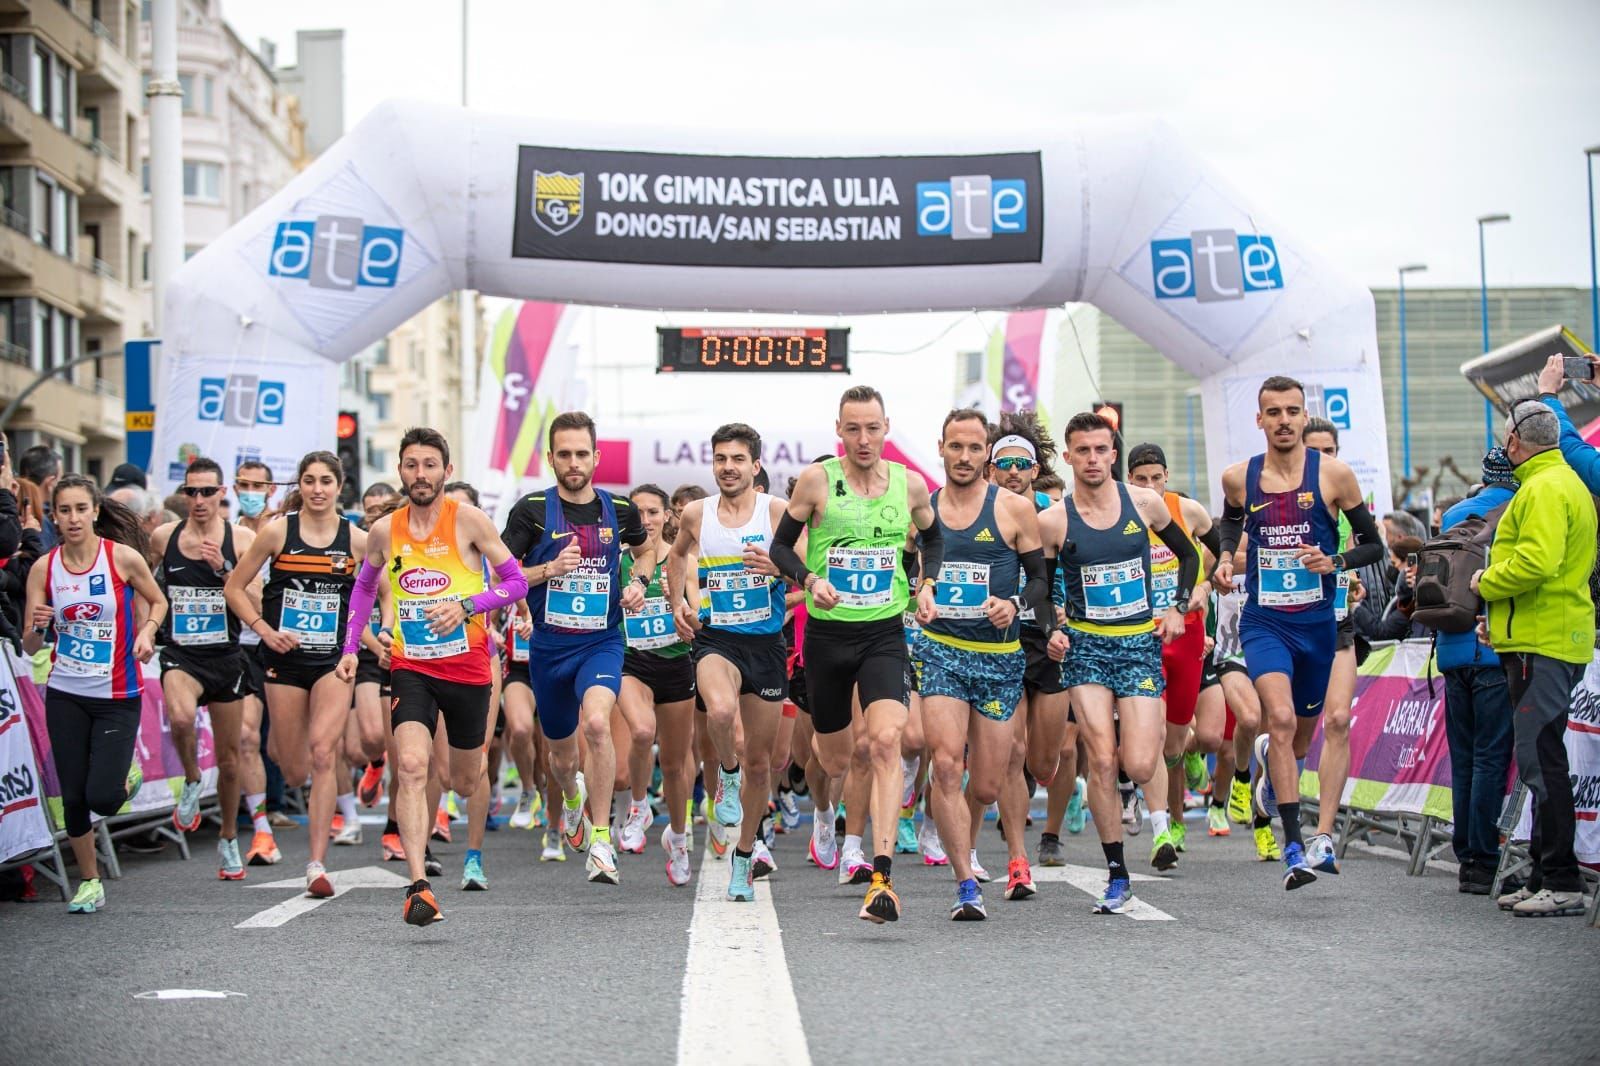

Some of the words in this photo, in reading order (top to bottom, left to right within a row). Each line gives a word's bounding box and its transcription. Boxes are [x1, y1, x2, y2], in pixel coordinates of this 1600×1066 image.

[598, 172, 649, 202] 10K
[654, 174, 828, 207] GIMNASTICA
[833, 177, 899, 206] ULIA
[919, 180, 1024, 234] ate
[596, 212, 770, 243] DONOSTIA/SAN
[775, 216, 901, 241] SEBASTIAN
[271, 221, 401, 287] ate
[1156, 235, 1277, 296] ate
[701, 336, 827, 366] 0:00:03
[201, 378, 284, 424] ate
[1260, 521, 1310, 536] FUNDACIÓ
[741, 534, 765, 544] HOKA
[1268, 535, 1303, 547] BARÇA
[578, 555, 607, 567] DACIÓ
[881, 557, 894, 565] DV
[1260, 557, 1272, 565] DV
[403, 576, 446, 589] Serrano
[753, 576, 766, 585] DV
[847, 573, 877, 591] 10
[973, 572, 986, 580] DV
[1085, 574, 1097, 582] DV
[1130, 567, 1141, 577] DV
[1282, 572, 1297, 590] 8
[1339, 577, 1348, 585] DV
[314, 581, 343, 589] VICKY
[550, 579, 564, 587] DV
[732, 592, 746, 609] 5
[949, 586, 964, 604] 2
[1110, 586, 1122, 603] 1
[285, 597, 296, 605] DV
[327, 601, 337, 609] DV
[571, 596, 586, 613] 6
[400, 608, 410, 617] DV
[186, 616, 212, 632] 87
[296, 613, 323, 629] 20
[640, 618, 666, 635] 18
[98, 630, 112, 638] DV
[70, 640, 95, 660] 26
[760, 687, 782, 696] HOKA
[1383, 699, 1430, 736] LABORAL
